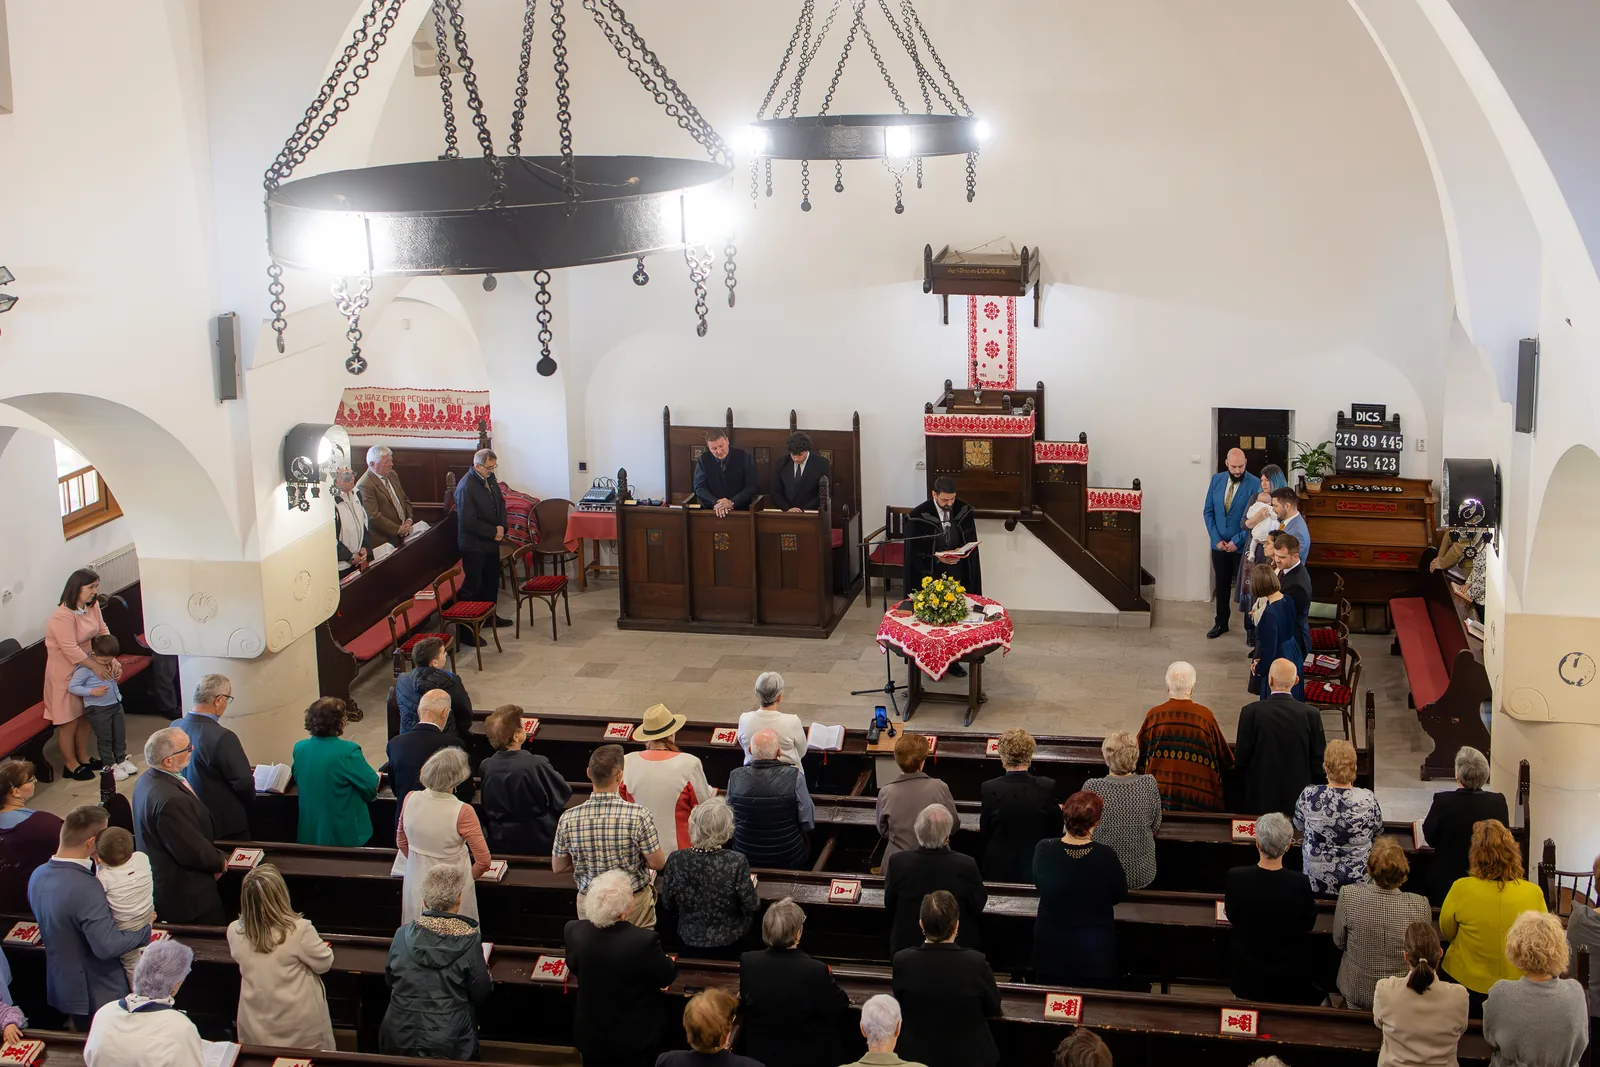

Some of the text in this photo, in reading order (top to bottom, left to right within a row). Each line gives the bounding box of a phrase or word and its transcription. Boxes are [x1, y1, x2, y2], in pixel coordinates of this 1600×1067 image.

[382, 395, 406, 403] EMBER
[407, 395, 429, 403] PEDIG
[1356, 412, 1382, 422] DICS.
[1336, 433, 1402, 449] 279 89 445
[1346, 456, 1396, 470] 255 423
